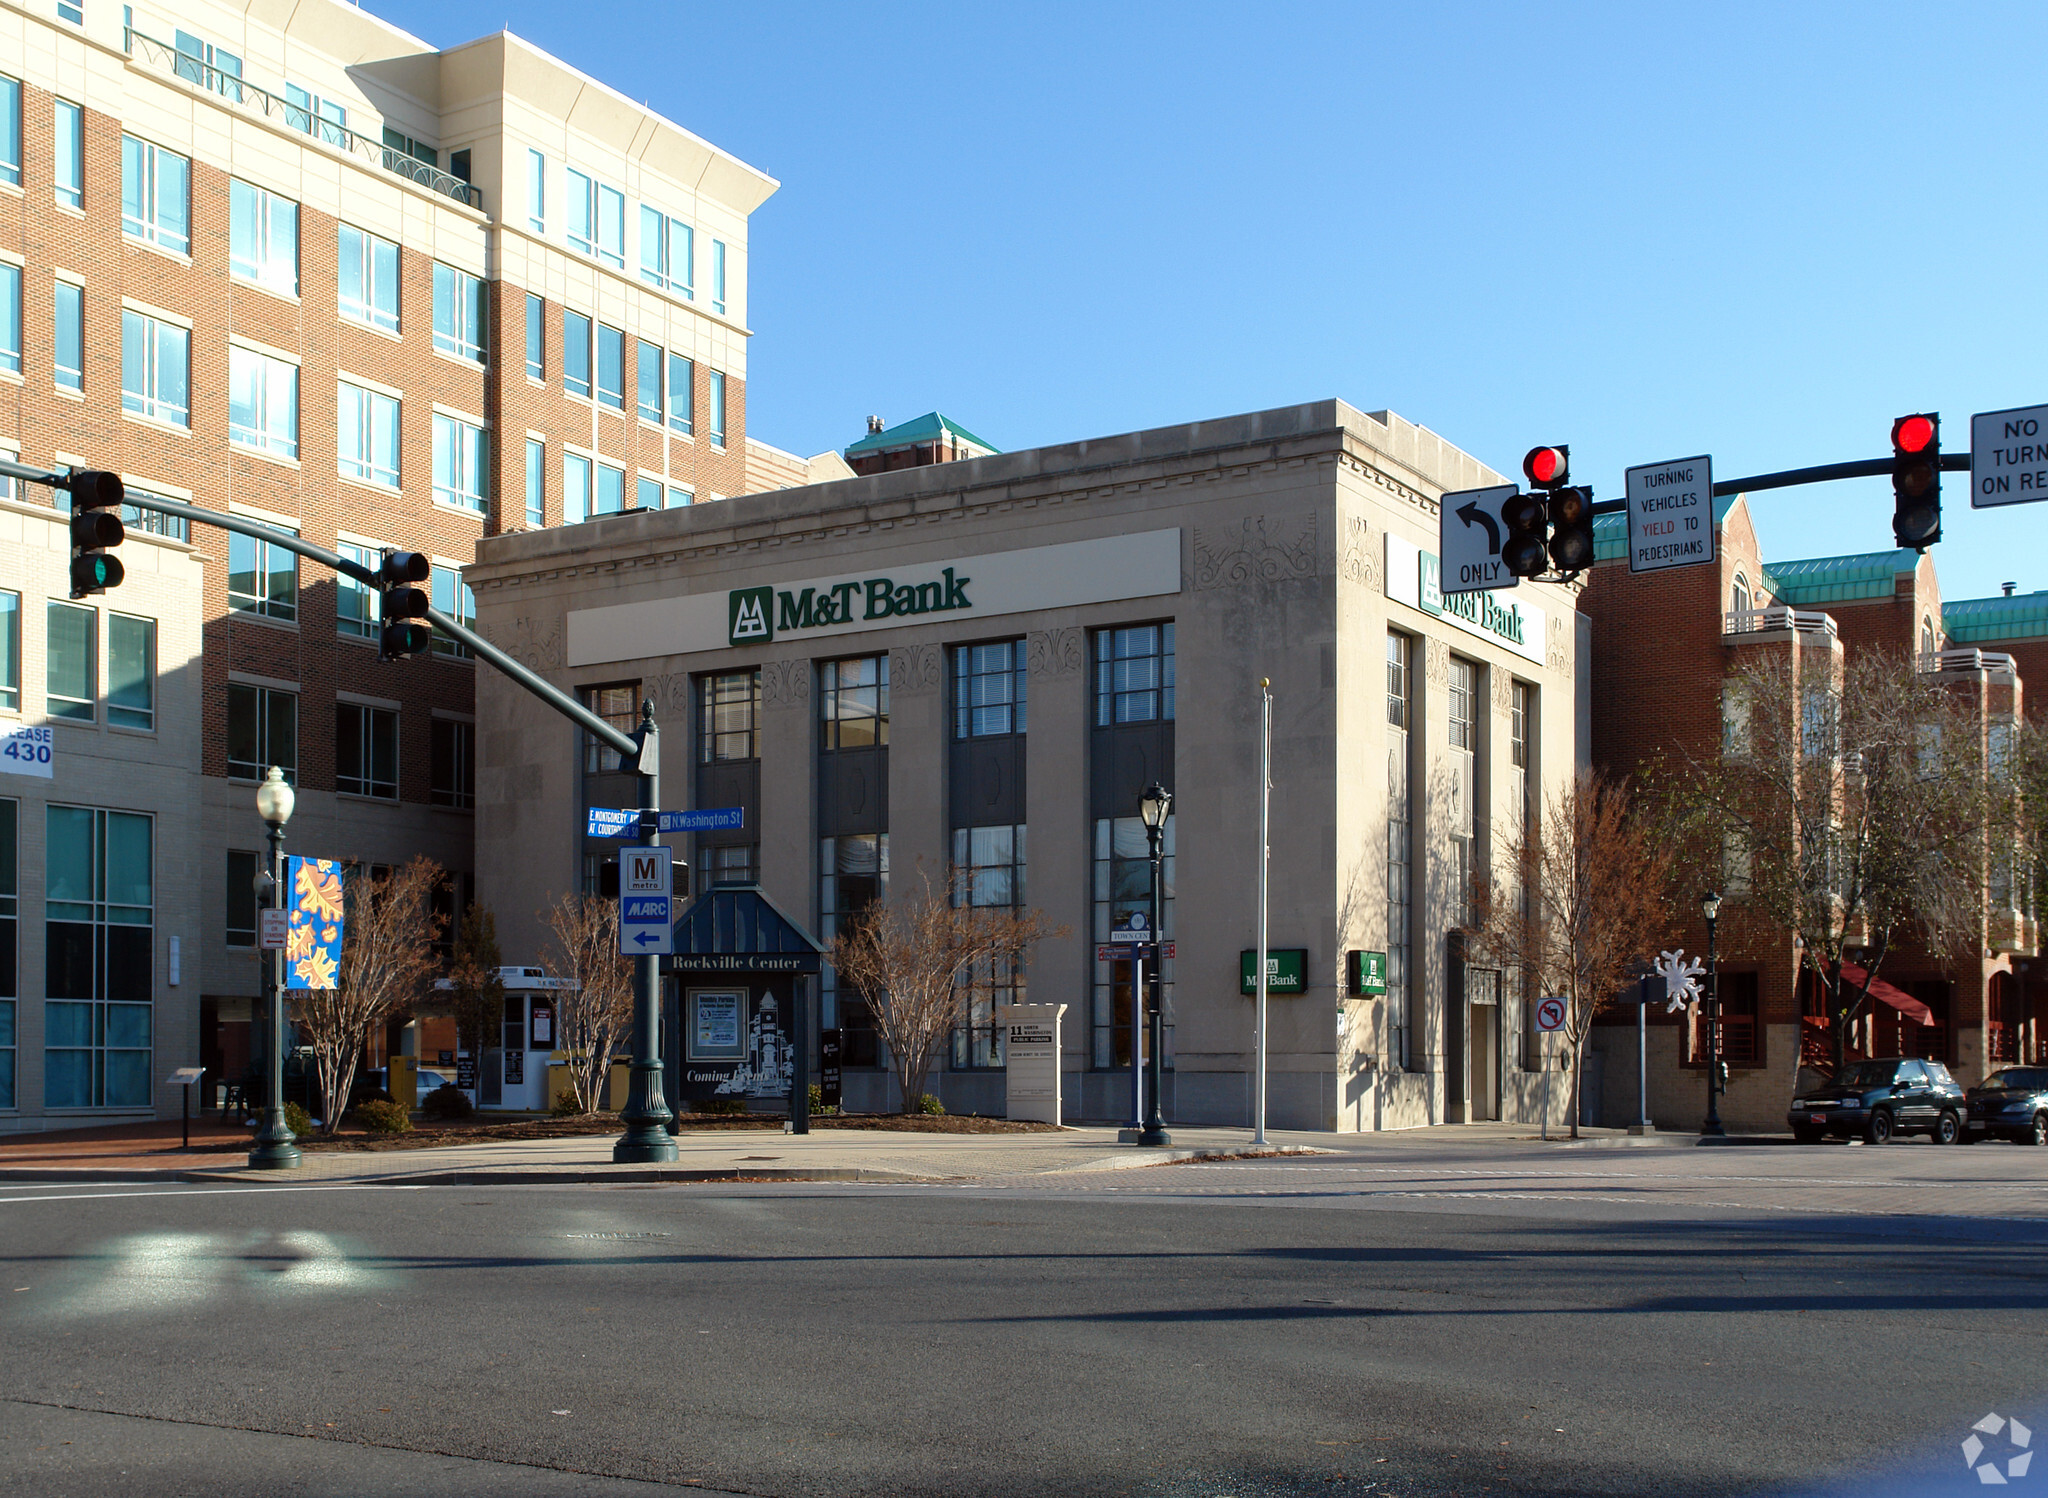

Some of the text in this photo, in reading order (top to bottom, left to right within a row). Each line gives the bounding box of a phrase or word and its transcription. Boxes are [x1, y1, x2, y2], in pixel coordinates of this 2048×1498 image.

[2005, 419, 2038, 439] NO
[1993, 443, 2048, 466] TURN
[1643, 468, 1694, 488] TURNING
[1982, 471, 2048, 494] ON RE
[1641, 492, 1697, 512] VEHICLES
[1642, 516, 1698, 537] YIELD TO
[1639, 540, 1703, 562] PEDESTRIANS
[1460, 561, 1501, 583] ONLY
[777, 567, 972, 631] M&T Bank
[1481, 590, 1525, 645] Bank
[4, 741, 51, 763] 430
[730, 811, 741, 824] St
[634, 858, 656, 880] M
[627, 902, 667, 916] MARC
[673, 955, 800, 969] Rockville Center
[1269, 974, 1298, 986] Bank
[1010, 1025, 1023, 1036] 11
[686, 1069, 730, 1084] Coming
